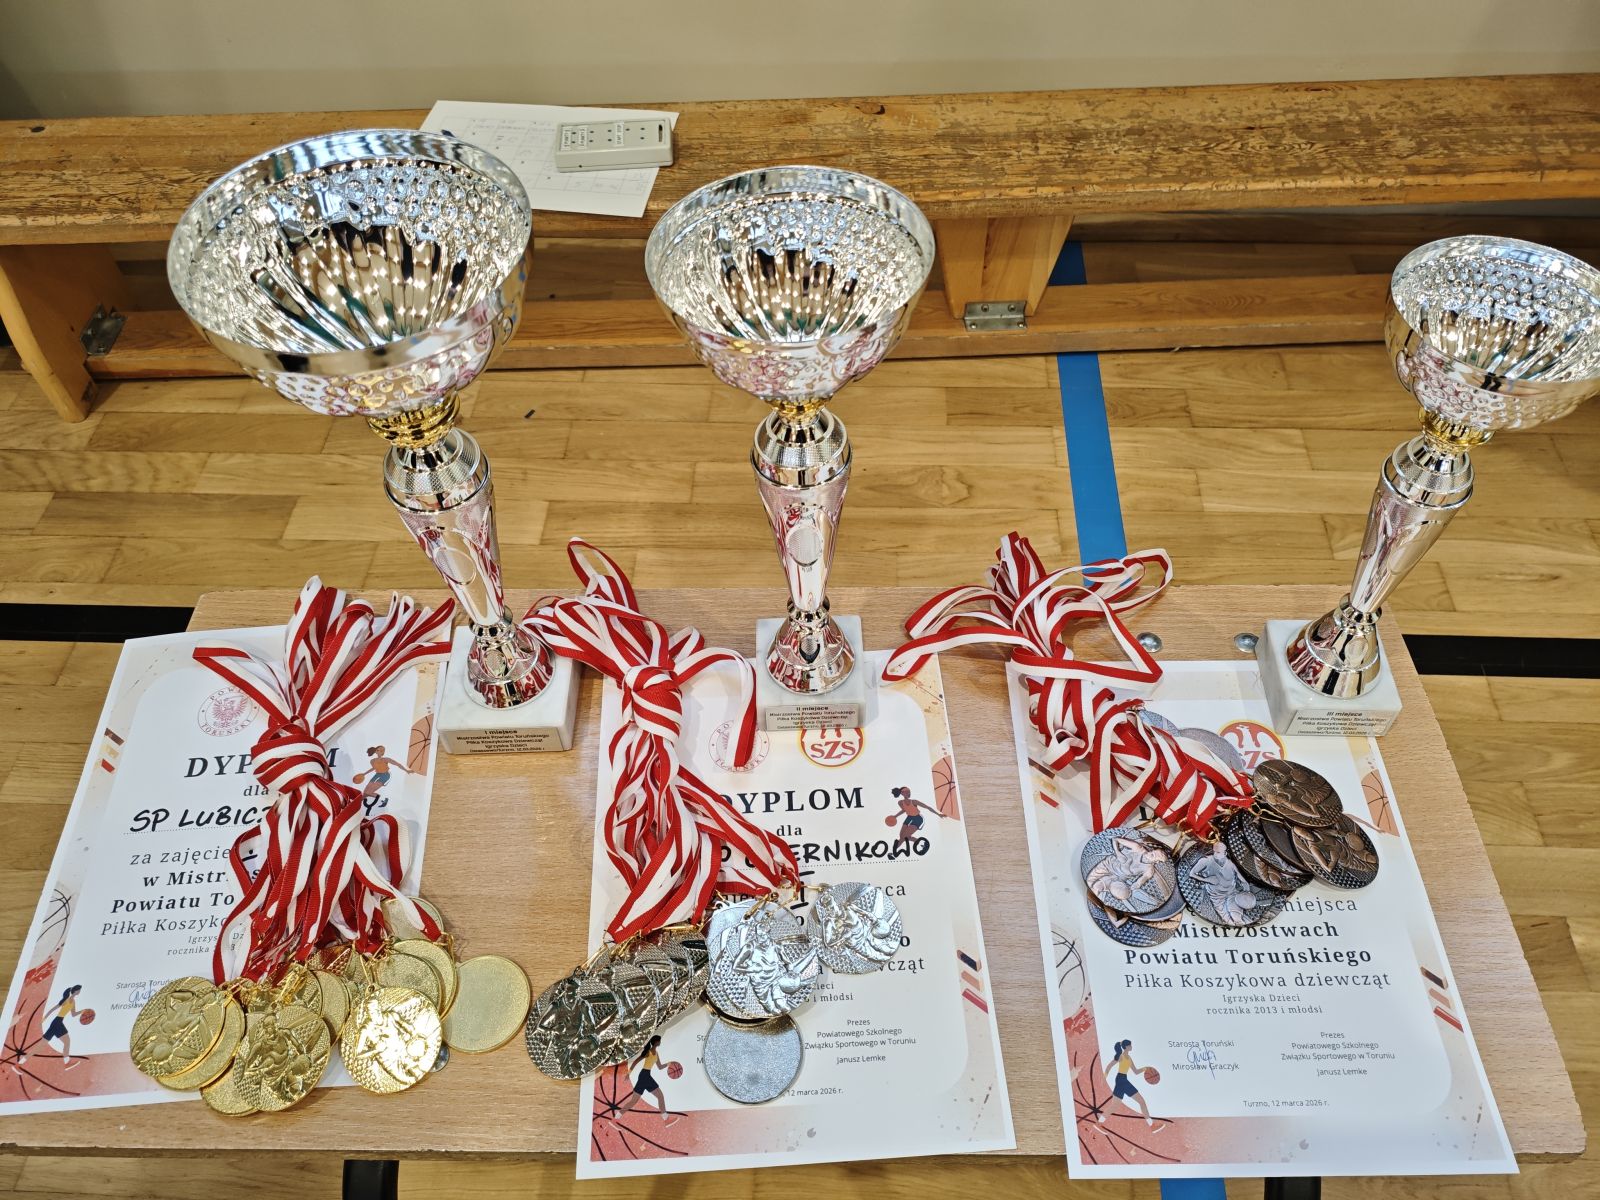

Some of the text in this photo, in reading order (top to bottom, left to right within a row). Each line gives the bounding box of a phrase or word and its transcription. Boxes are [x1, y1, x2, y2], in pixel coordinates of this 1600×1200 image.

[810, 740, 856, 759] SZS
[244, 784, 269, 797] dla
[130, 807, 170, 833] SP
[776, 824, 803, 837] dla
[130, 853, 152, 866] za
[160, 846, 231, 866] zajęcie
[143, 876, 160, 887] w
[110, 896, 200, 913] Powiatu
[101, 920, 147, 936] Piłka
[189, 935, 218, 945] Igrzys
[167, 945, 210, 956] rocznika
[1124, 946, 1371, 968] Powiatu Toruńskiego
[1124, 971, 1391, 991] Piłka Koszykowa dziewcząt
[820, 992, 853, 1002] młodsi
[1223, 992, 1301, 1005] Igrzyska Dzieci
[1206, 1004, 1250, 1015] rocznika
[1254, 1004, 1277, 1014] 2013
[1288, 1003, 1323, 1014] młodsi
[817, 1027, 903, 1040] Powiatowego Szkolnego
[1320, 1031, 1345, 1039] Prezes
[804, 1041, 834, 1051] Związku
[835, 1038, 878, 1049] Sportowego
[888, 1037, 916, 1046] Toruniu
[1168, 1040, 1200, 1048] Starosta
[1291, 1041, 1379, 1051] Powiatowego Szkolnego
[837, 1056, 860, 1065] Janusz
[1281, 1053, 1311, 1062] Związku
[1312, 1052, 1357, 1061] Sportowego
[1366, 1051, 1396, 1060] Toruniu
[1172, 1063, 1208, 1071] Mirosław
[1317, 1068, 1341, 1077] Janusz
[820, 1087, 837, 1095] 2026
[1242, 1100, 1270, 1108] Turzno,
[1305, 1099, 1323, 1107] 2026
